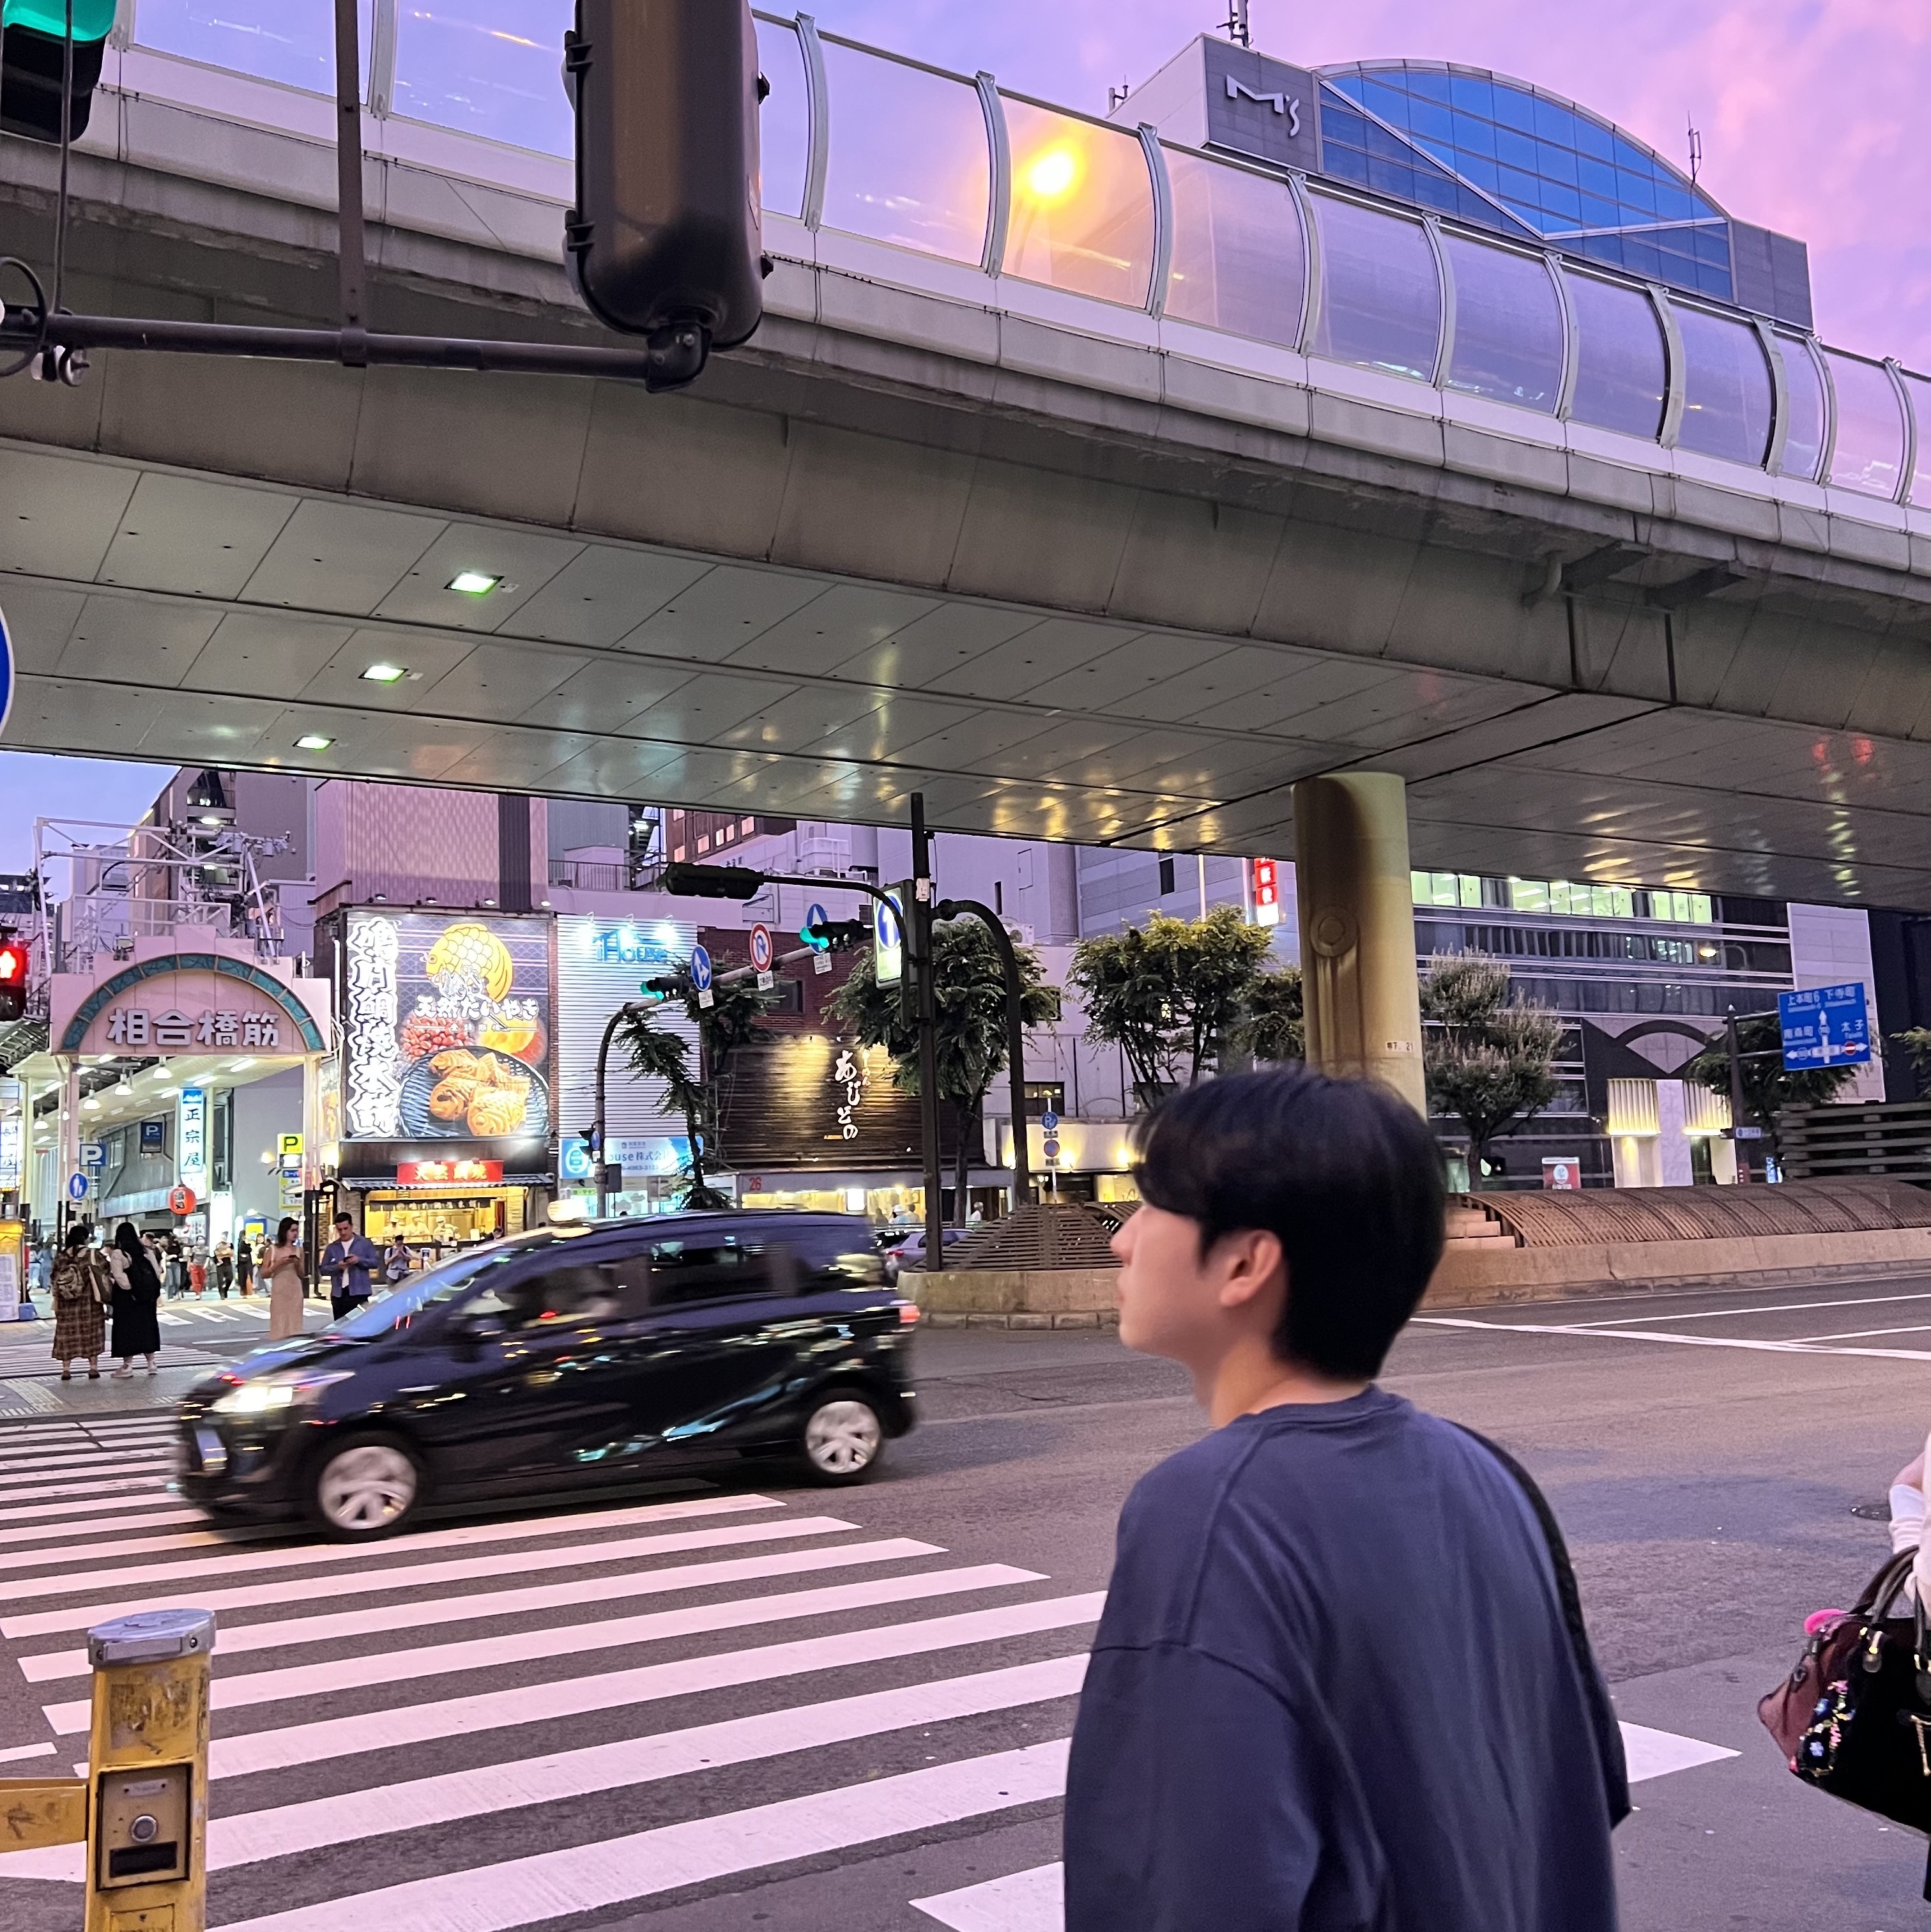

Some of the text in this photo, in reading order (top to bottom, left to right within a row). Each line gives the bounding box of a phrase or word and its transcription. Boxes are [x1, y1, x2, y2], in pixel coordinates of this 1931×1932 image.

[414, 994, 539, 1021] 天然たいやき
[107, 1008, 280, 1046] 相合橋筋
[835, 1050, 861, 1140] あじどの
[146, 1125, 159, 1136] P
[184, 1108, 201, 1167] 正宗屋
[80, 1145, 103, 1165] P
[284, 1136, 298, 1152] P
[749, 1176, 761, 1191] 26
